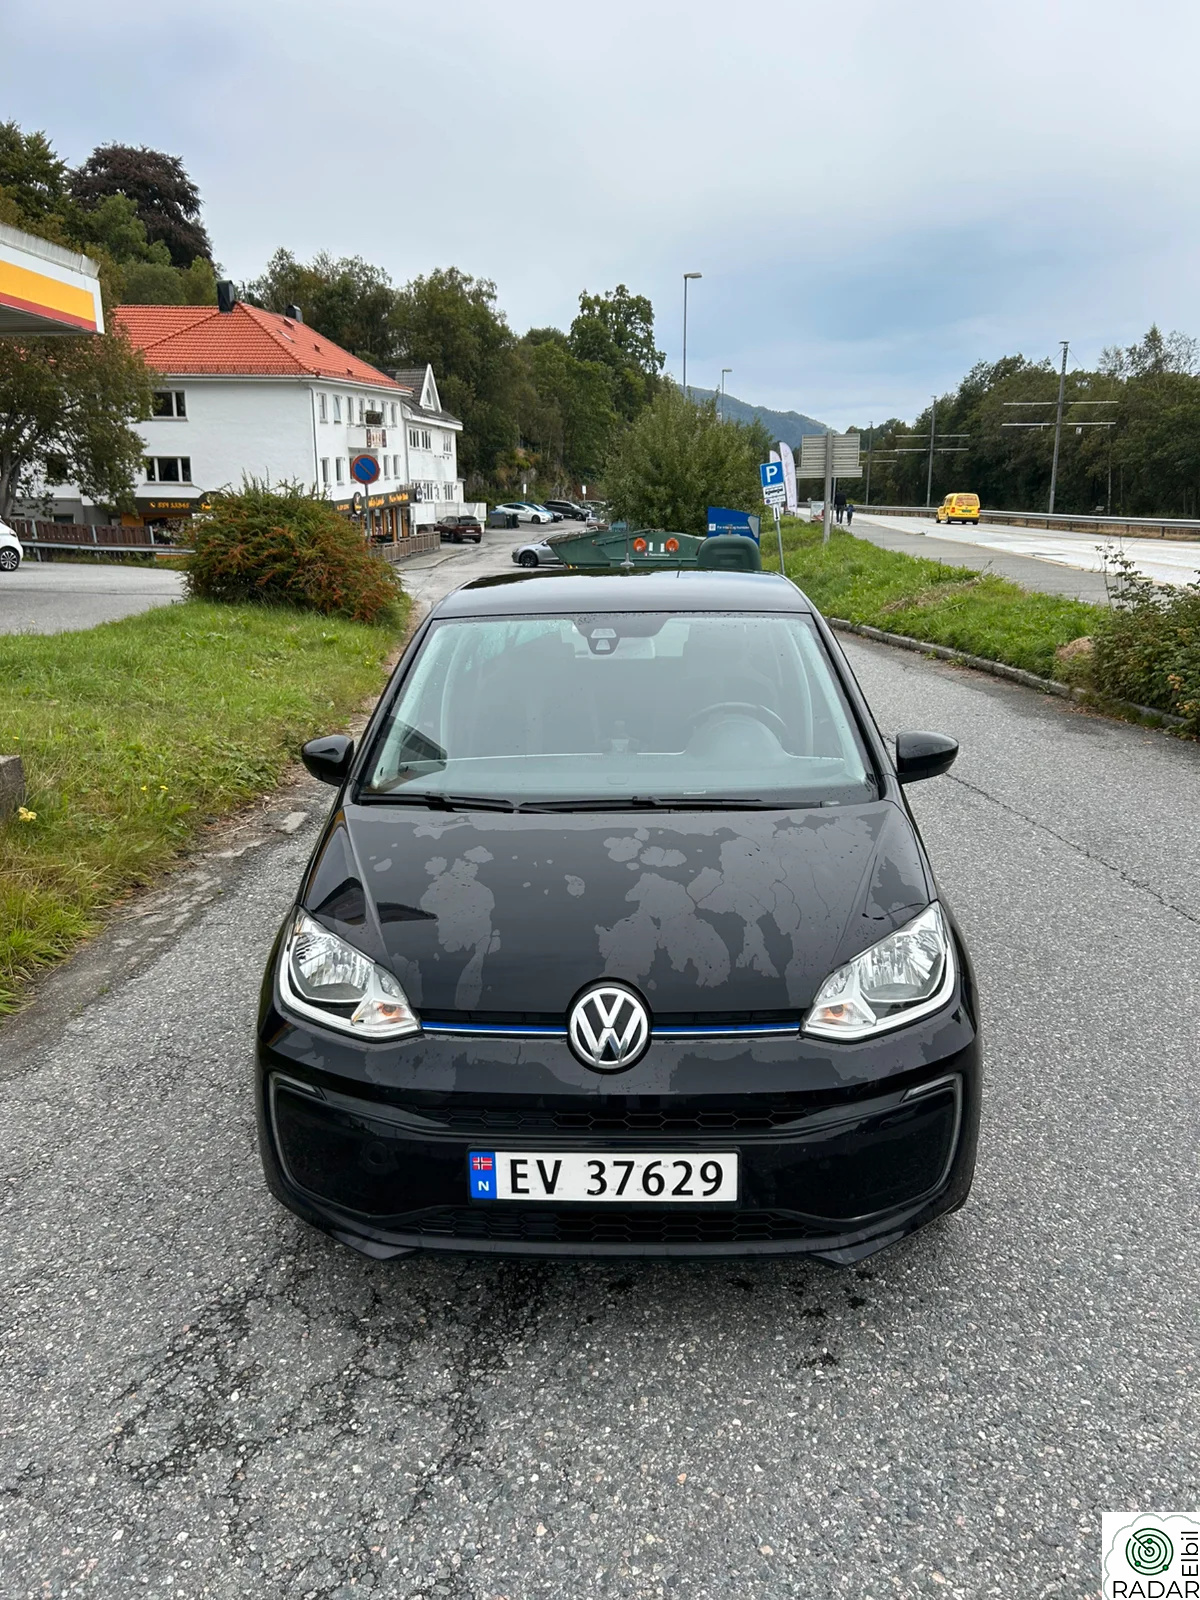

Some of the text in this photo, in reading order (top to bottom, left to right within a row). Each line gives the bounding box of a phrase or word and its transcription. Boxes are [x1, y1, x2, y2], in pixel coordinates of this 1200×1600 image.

[765, 465, 778, 483] P
[570, 987, 648, 1067] VW
[478, 1181, 489, 1191] N
[510, 1159, 723, 1197] EV 37629
